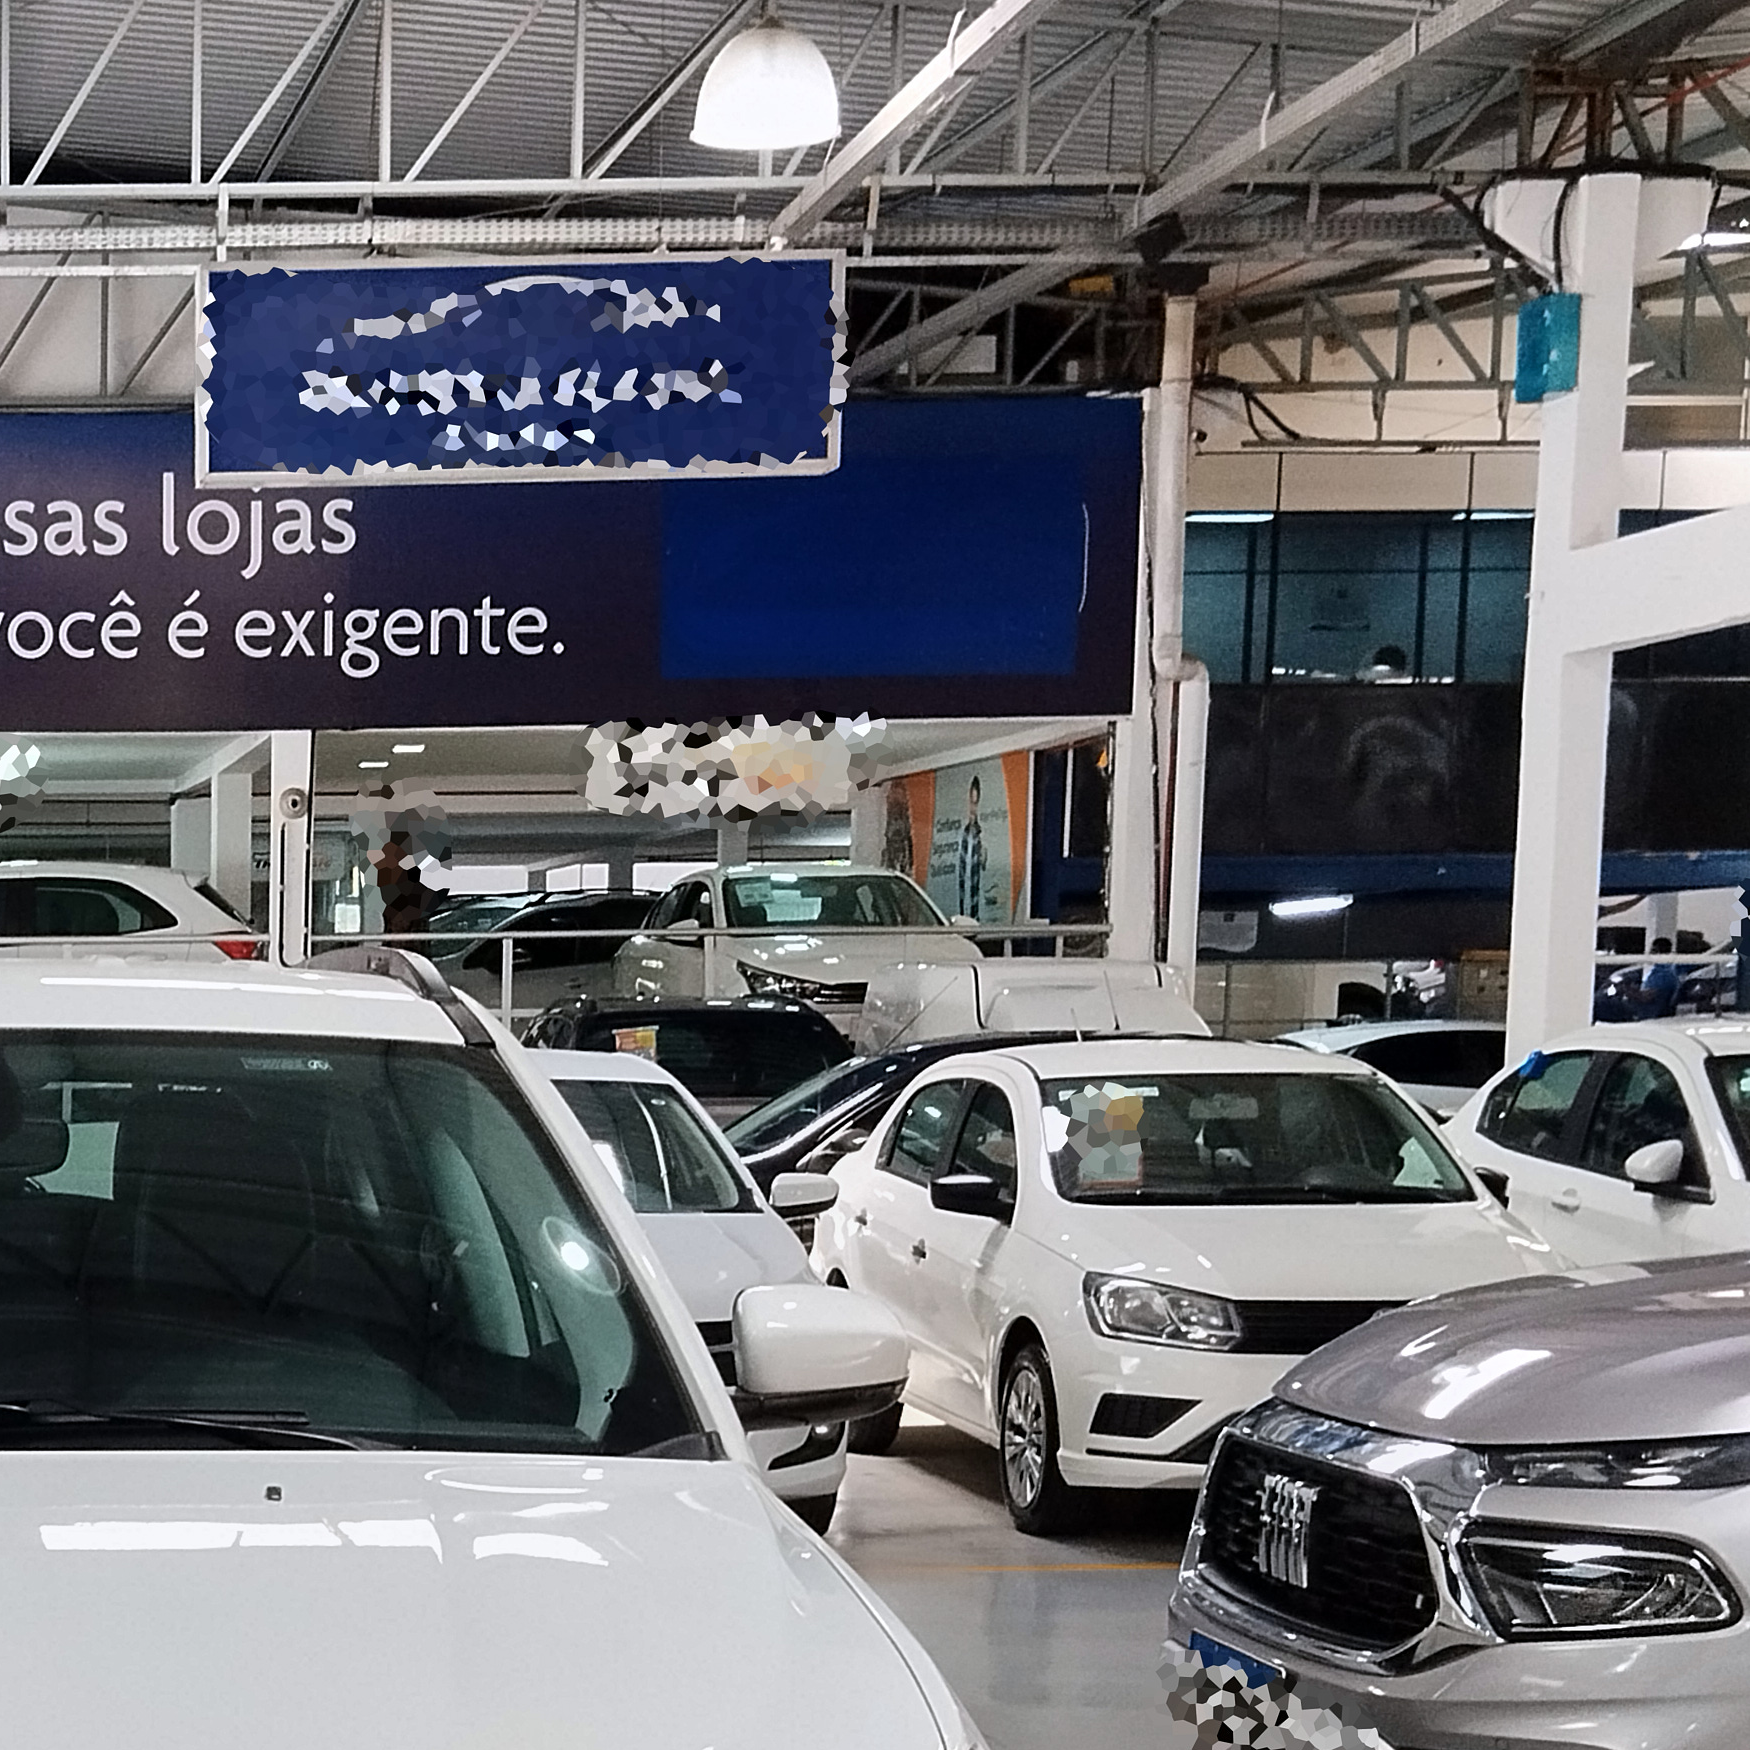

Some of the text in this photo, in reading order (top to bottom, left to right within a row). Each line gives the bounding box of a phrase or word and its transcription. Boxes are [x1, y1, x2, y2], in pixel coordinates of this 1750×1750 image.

[162, 472, 358, 580] lojas
[168, 590, 209, 659] é
[235, 592, 567, 679] exigente.
